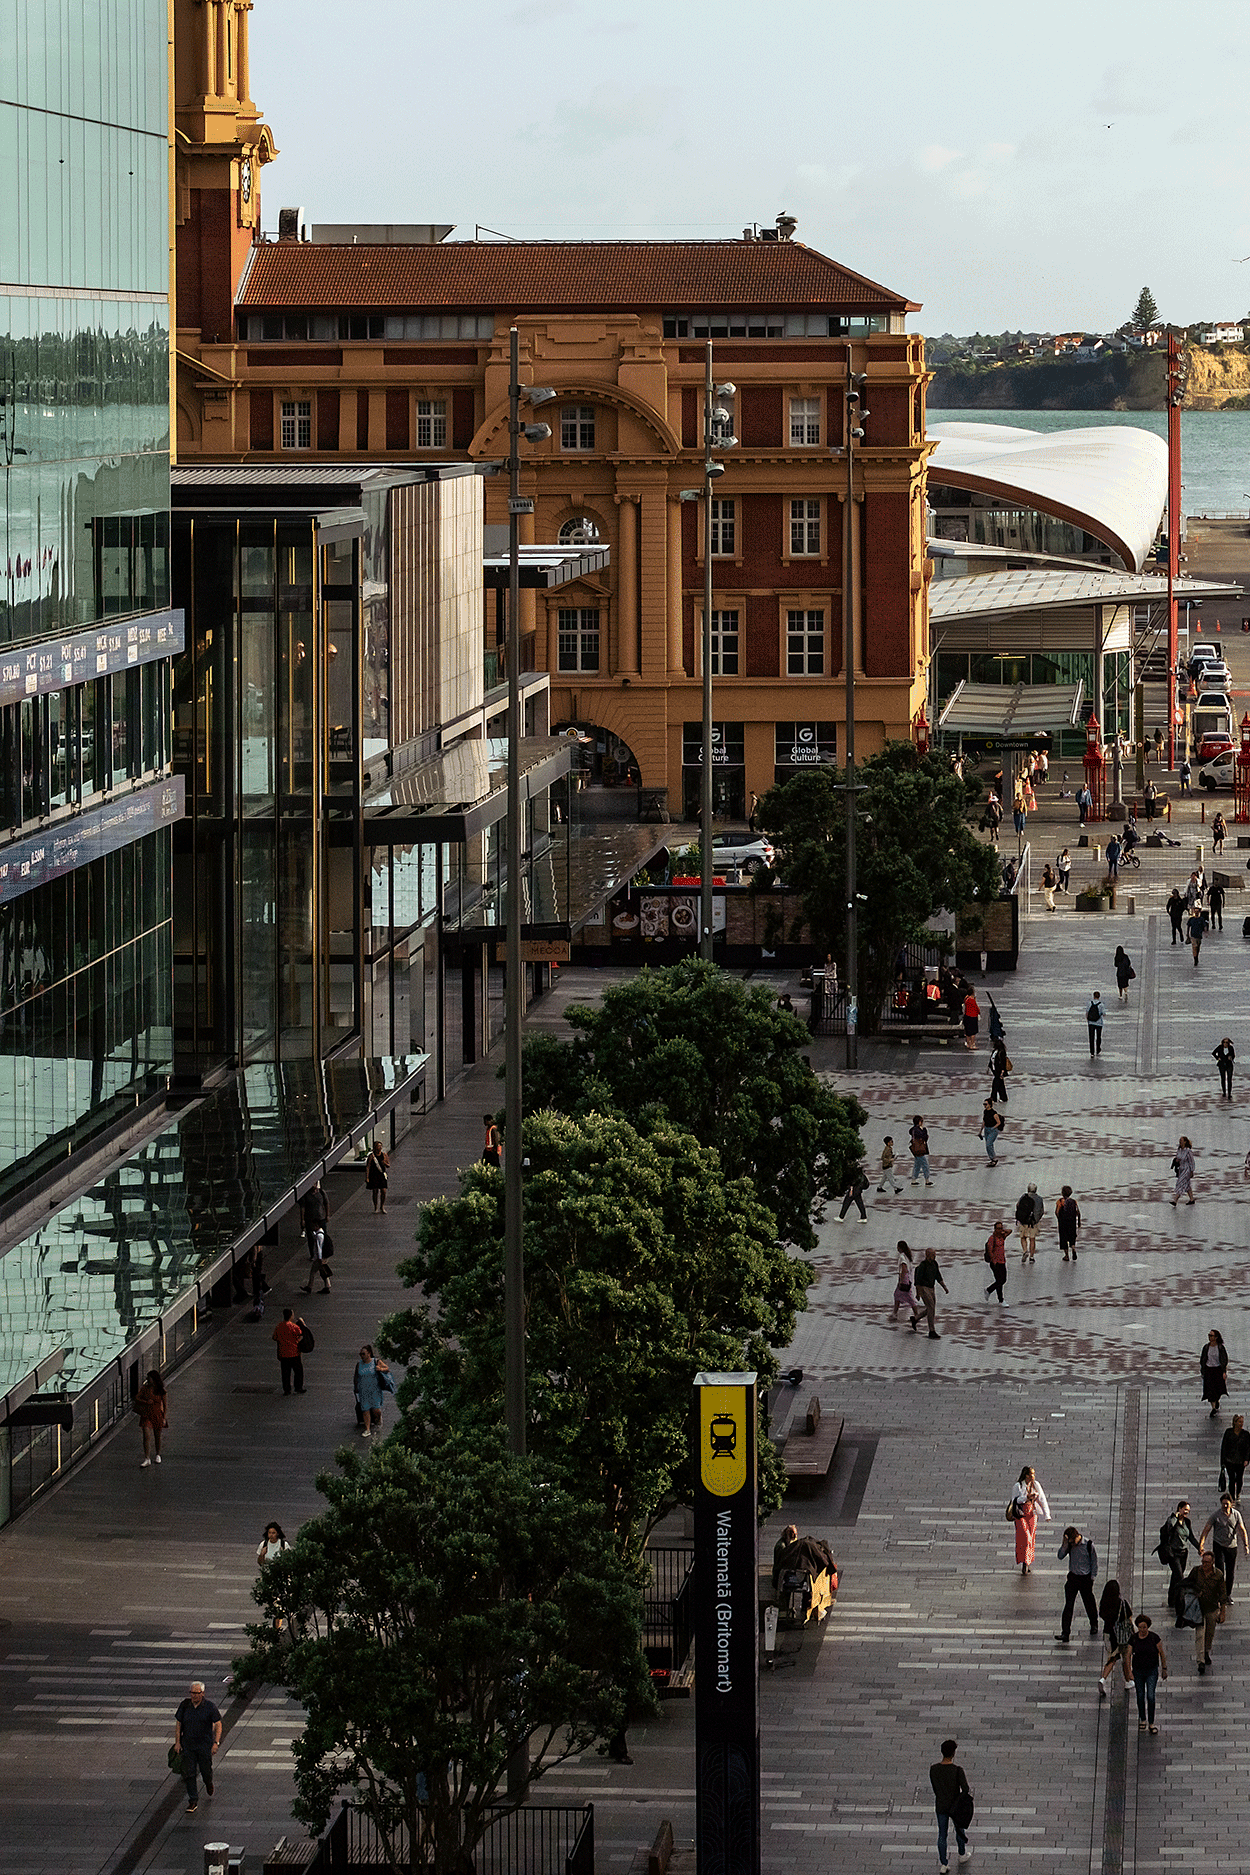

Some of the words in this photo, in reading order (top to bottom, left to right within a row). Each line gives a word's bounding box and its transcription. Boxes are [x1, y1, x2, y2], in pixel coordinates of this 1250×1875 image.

[791, 746, 819, 754] Global
[698, 754, 729, 762] Cture
[790, 754, 822, 762] Culture
[531, 946, 567, 955] MECCA
[716, 1509, 732, 1598] Waitematā
[715, 1602, 733, 1694] (Britomart)
